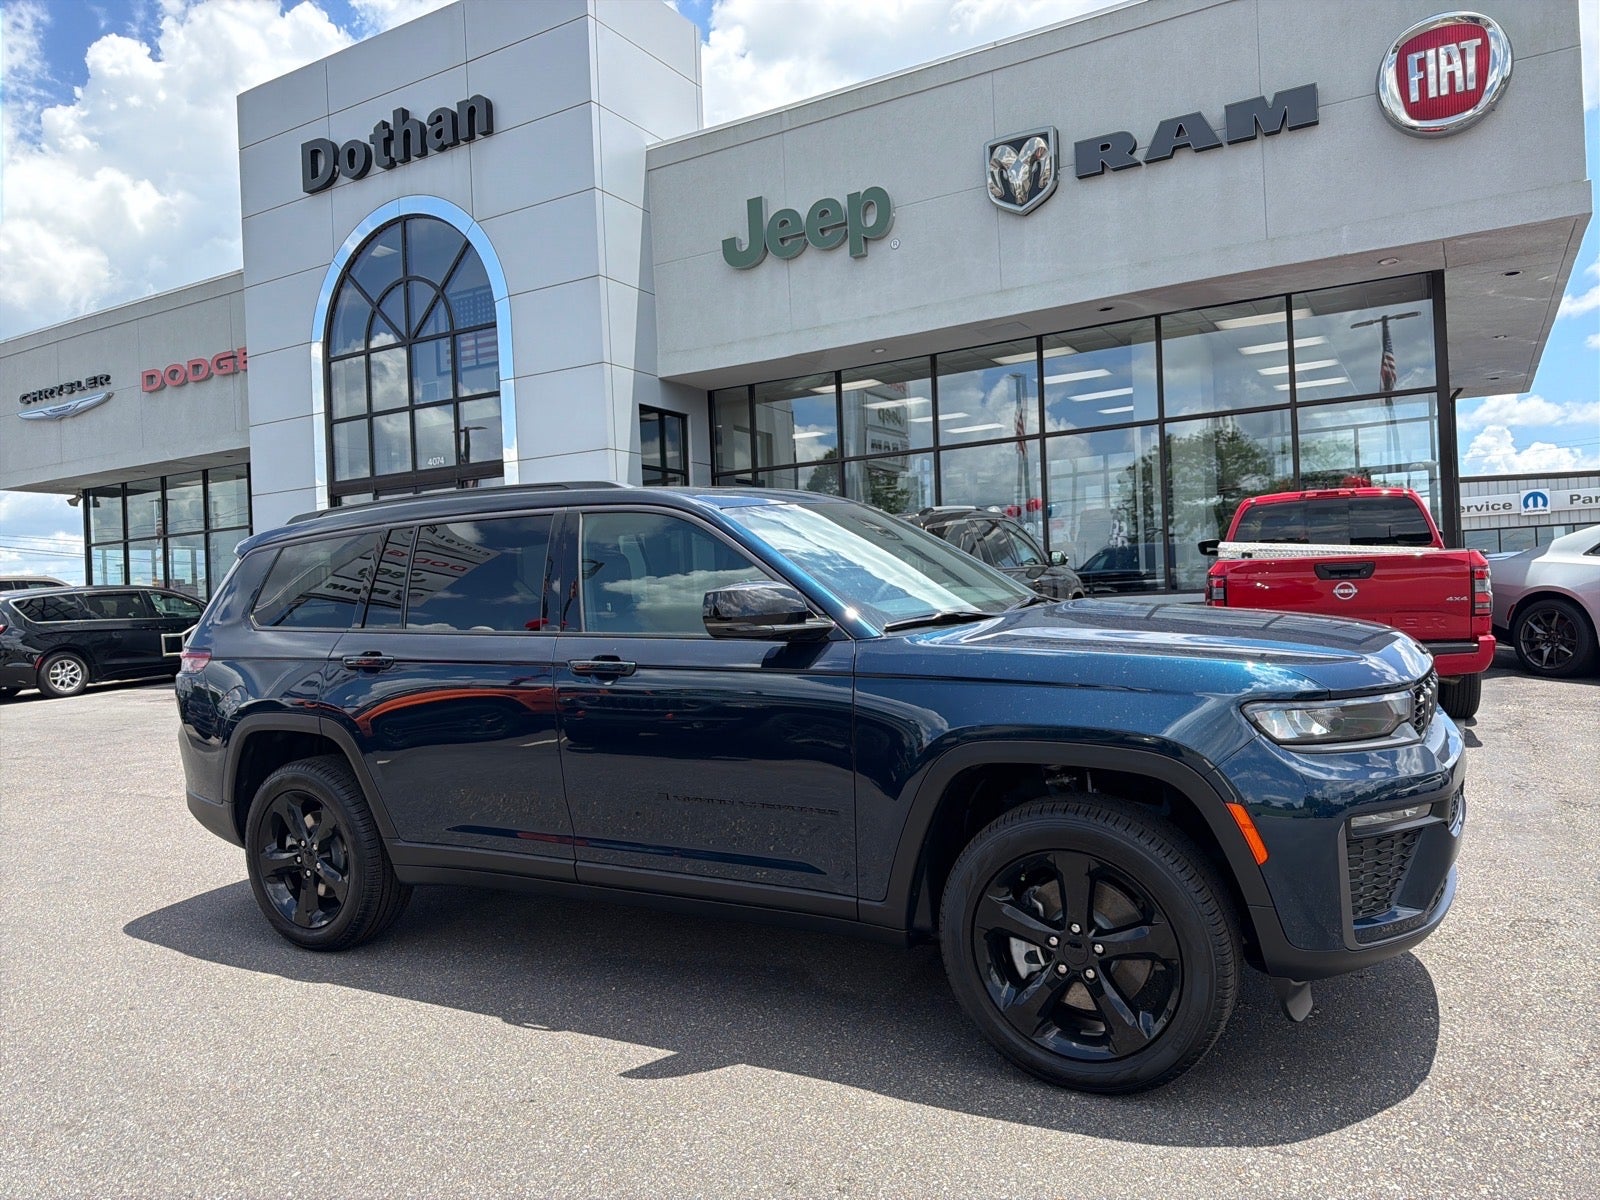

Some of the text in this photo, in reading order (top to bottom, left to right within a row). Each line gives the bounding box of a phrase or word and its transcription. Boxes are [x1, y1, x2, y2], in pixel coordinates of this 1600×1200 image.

[1407, 38, 1482, 104] FIAT
[301, 94, 494, 194] Dothan
[1074, 82, 1319, 179] RAM
[721, 186, 895, 270] Jeep
[19, 373, 112, 405] CHRYSLER
[427, 456, 445, 466] 4074
[1460, 501, 1513, 513] ervice
